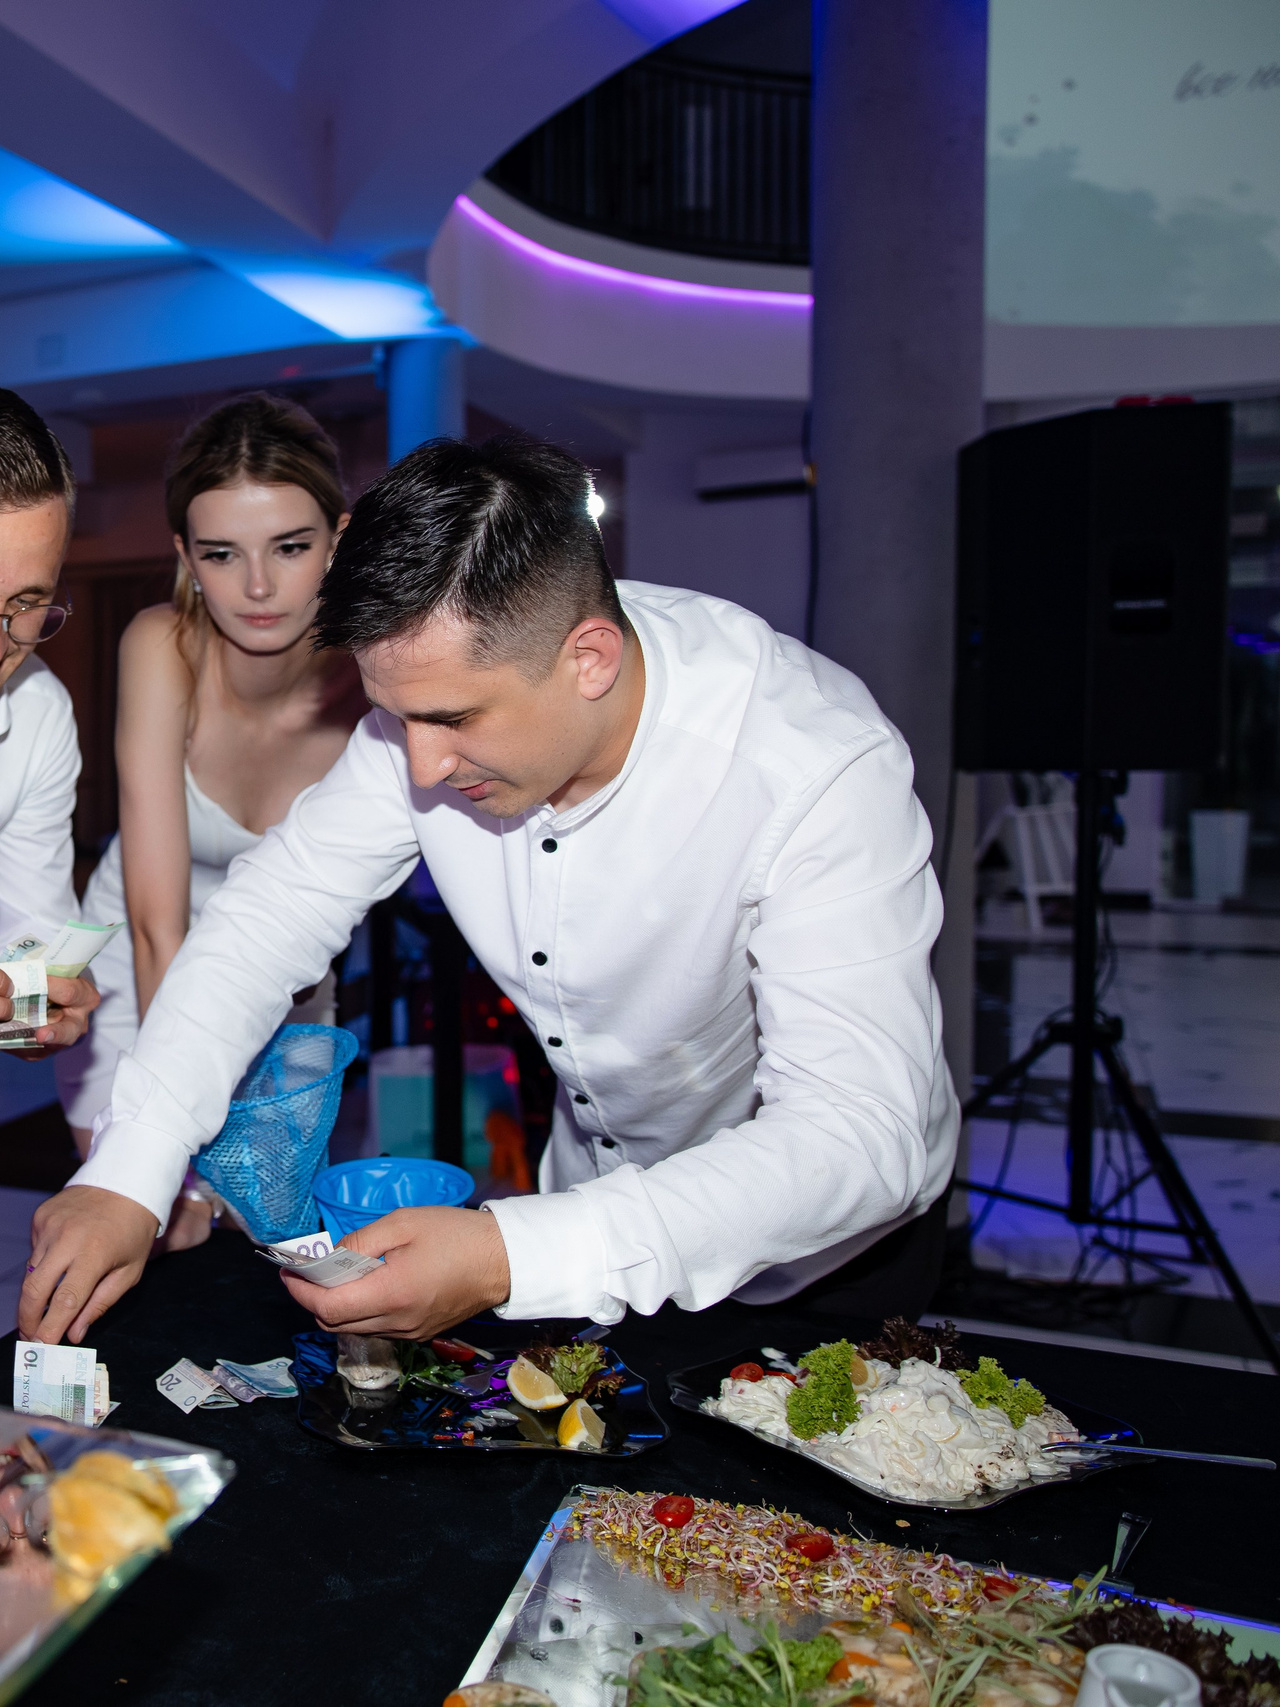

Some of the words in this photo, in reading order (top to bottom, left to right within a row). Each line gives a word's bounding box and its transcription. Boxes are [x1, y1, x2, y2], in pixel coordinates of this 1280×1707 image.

[17, 939, 35, 950] 10
[23, 1350, 39, 1371] 10
[75, 1351, 88, 1383] NBP
[21, 1374, 31, 1409] POLSKI
[159, 1373, 182, 1392] 20
